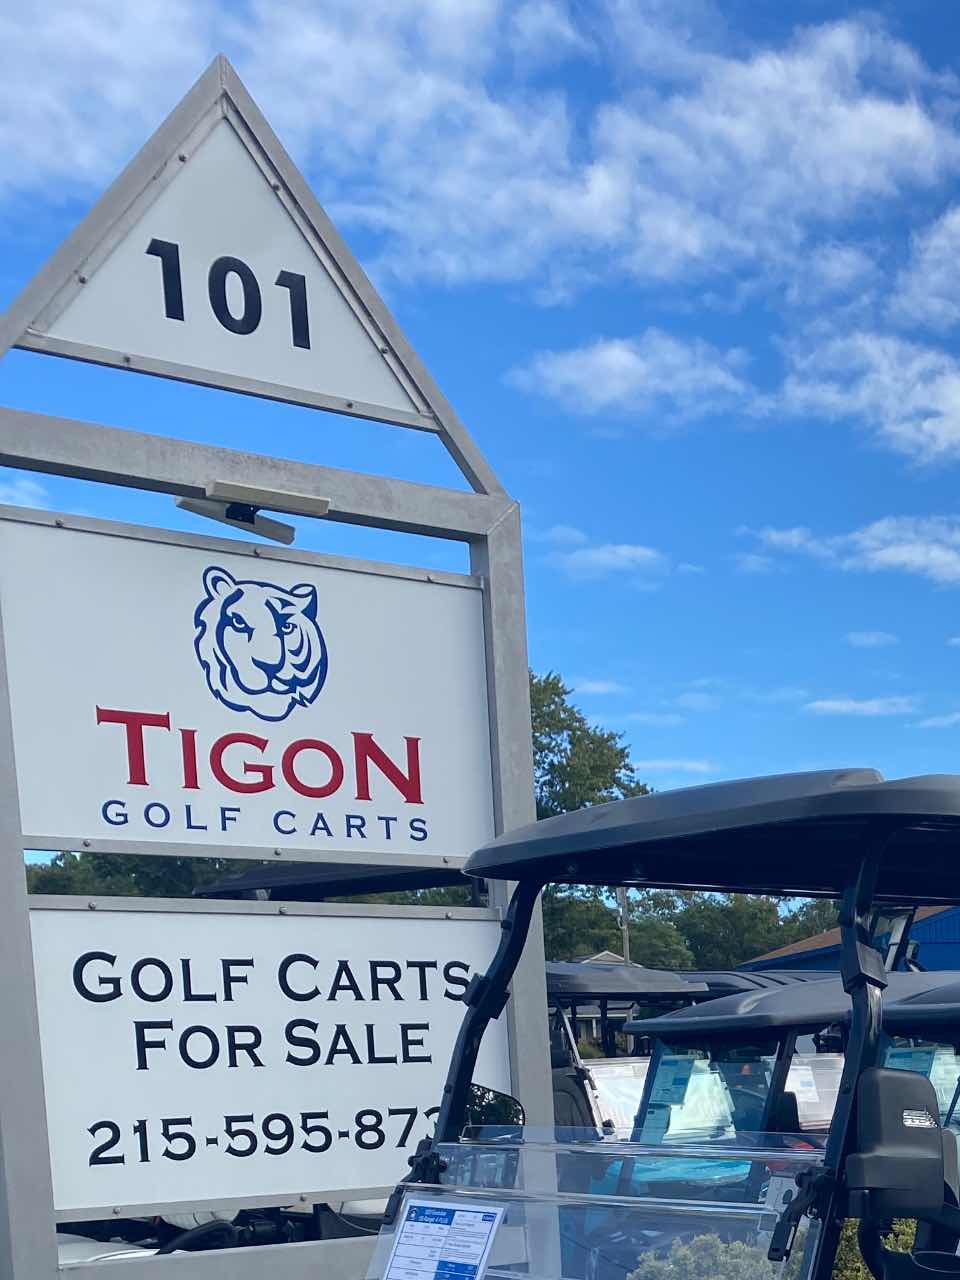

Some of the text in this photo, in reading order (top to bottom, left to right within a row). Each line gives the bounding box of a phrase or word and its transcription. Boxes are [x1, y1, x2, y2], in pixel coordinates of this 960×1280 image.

[145, 238, 312, 351] 101
[96, 704, 425, 805] TIGON
[101, 799, 428, 842] GOLF CARTS
[72, 951, 471, 1004] GOLF CARTS
[133, 1018, 433, 1071] FOR SALE
